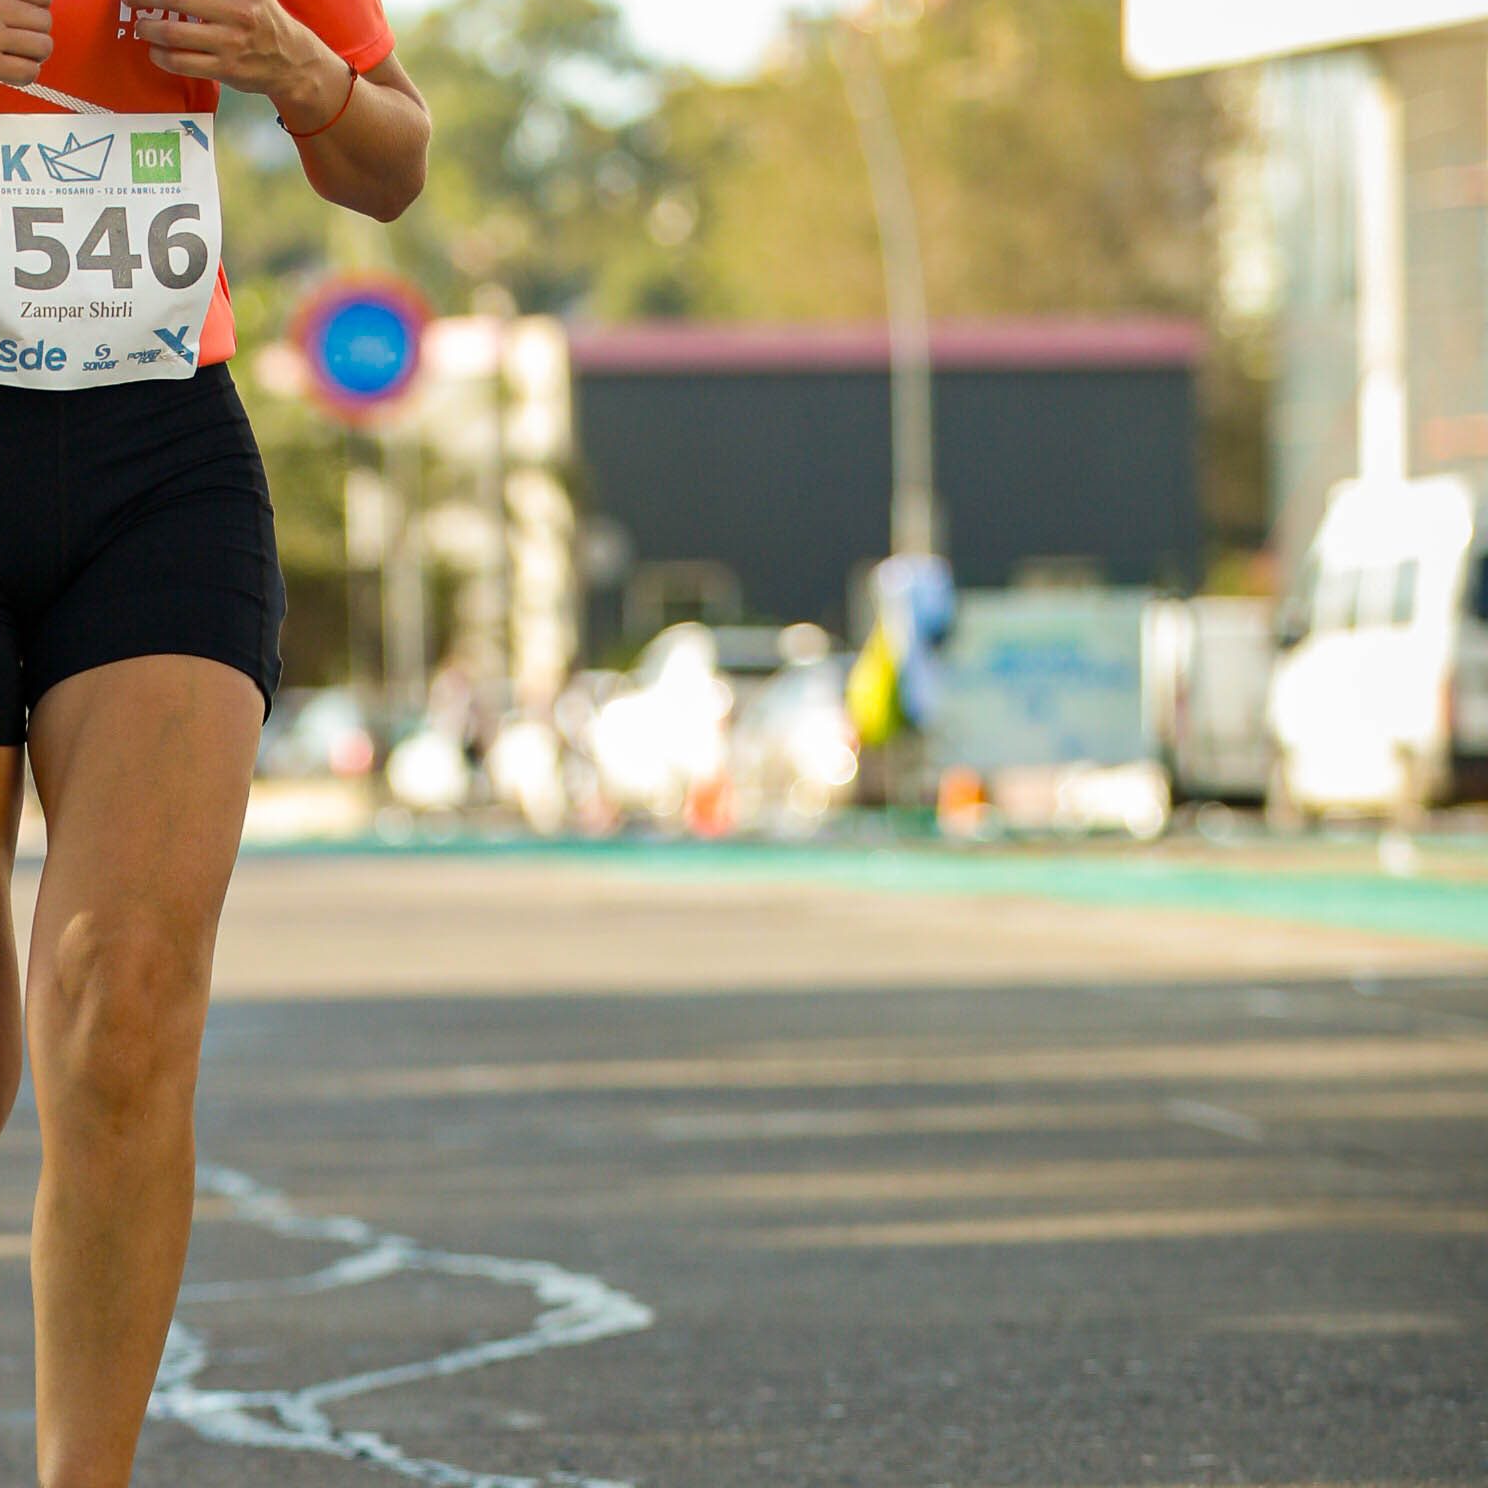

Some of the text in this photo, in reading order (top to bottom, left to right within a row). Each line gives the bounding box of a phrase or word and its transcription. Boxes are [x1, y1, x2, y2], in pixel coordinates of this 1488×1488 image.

[136, 149, 175, 168] 10K
[25, 188, 46, 196] 2026
[55, 187, 94, 196] ROSARIO
[104, 187, 114, 195] 12
[117, 187, 128, 195] DE
[131, 187, 156, 195] ABRIL
[160, 186, 182, 194] 2026
[20, 301, 133, 322] Zampar Shirli
